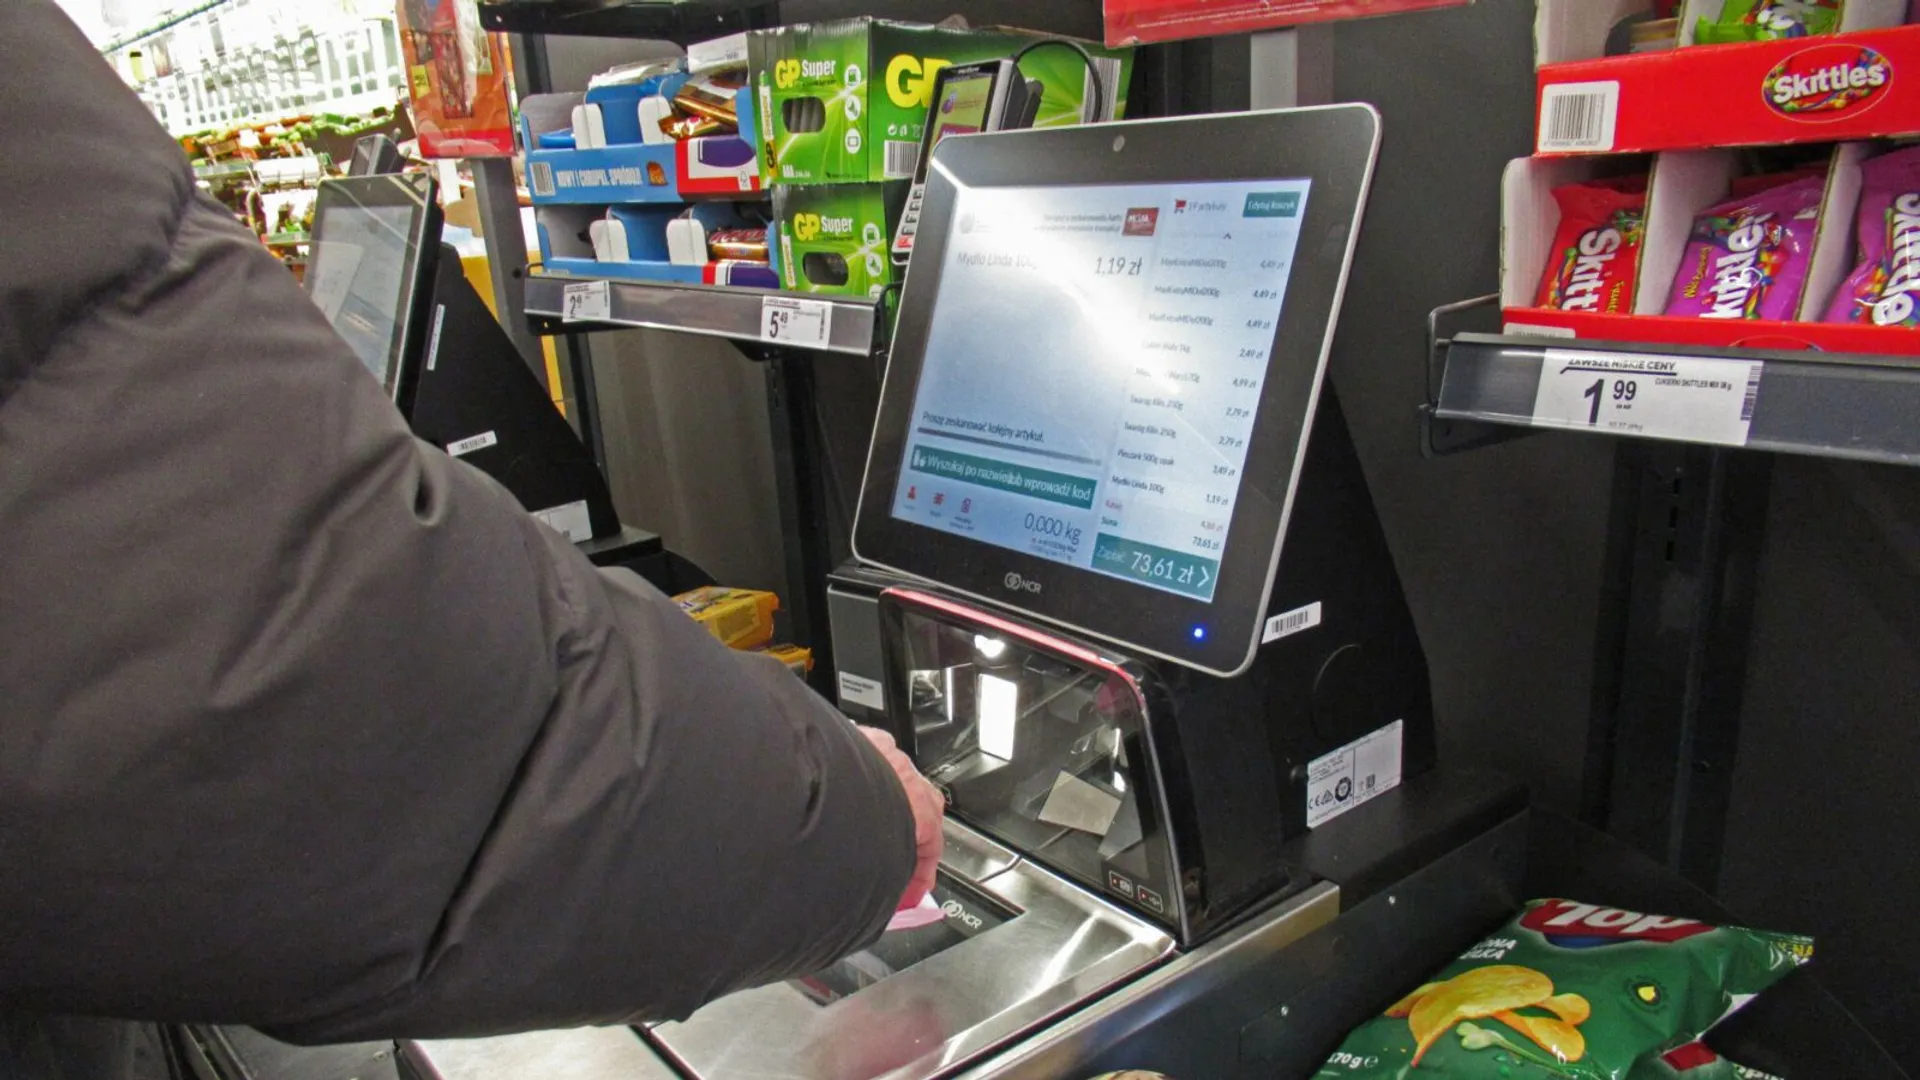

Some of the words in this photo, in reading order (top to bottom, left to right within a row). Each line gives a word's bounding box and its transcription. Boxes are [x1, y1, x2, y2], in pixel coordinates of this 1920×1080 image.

[775, 59, 801, 89] GP
[801, 59, 836, 79] Super
[1773, 64, 1885, 104] Skittles
[794, 213, 820, 241] GP
[821, 216, 853, 233] Super
[570, 295, 576, 318] 2
[770, 311, 779, 338] 5
[1646, 362, 1677, 371] CENY
[1584, 378, 1604, 427] 1
[1613, 380, 1637, 400] 99
[927, 454, 966, 475] Wyszukaj
[965, 466, 976, 478] po
[1023, 474, 1070, 498] wprowadź
[1071, 484, 1091, 500] kod
[1064, 522, 1082, 545] kg
[1129, 550, 1176, 581] 73,61
[1176, 562, 1195, 585] zł
[1022, 580, 1041, 594] NCR
[959, 911, 982, 929] NCR
